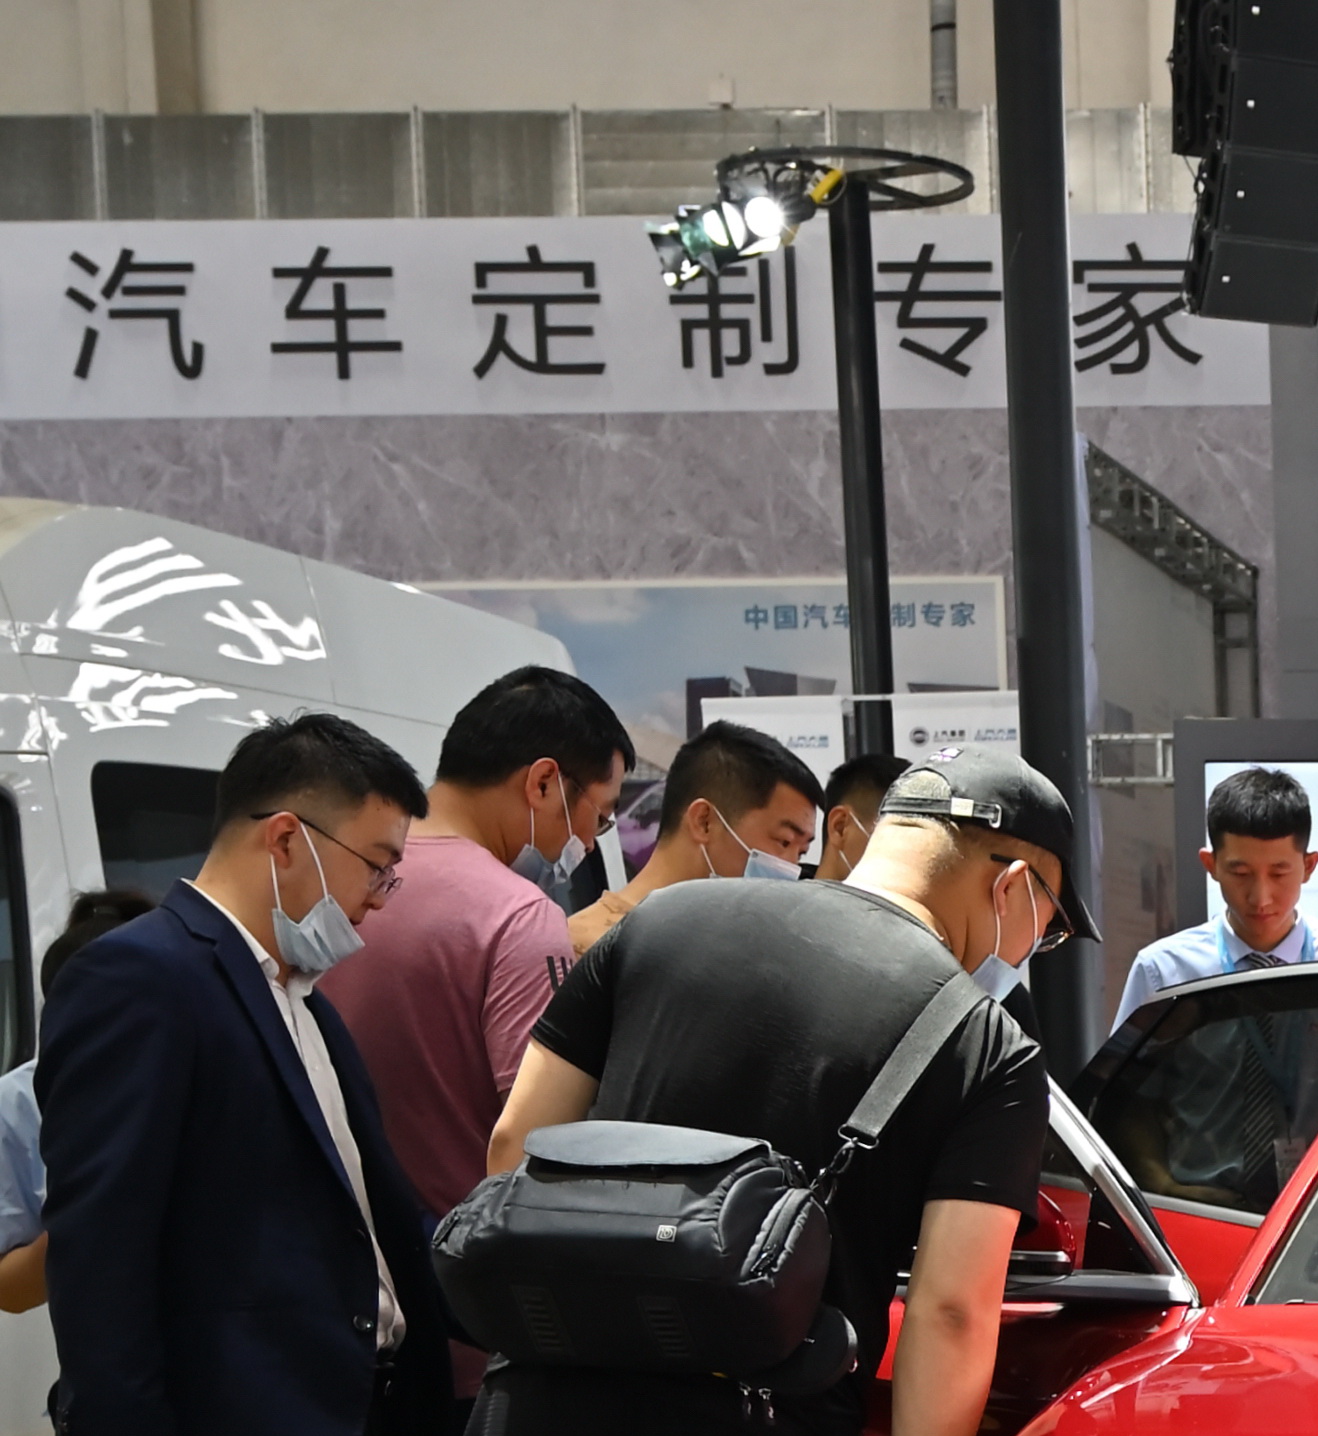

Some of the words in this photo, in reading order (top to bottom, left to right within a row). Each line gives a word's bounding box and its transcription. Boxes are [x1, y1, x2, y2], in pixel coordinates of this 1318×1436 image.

[66, 243, 1204, 380] 汽车定制专家
[744, 602, 976, 631] 中国汽车制专家
